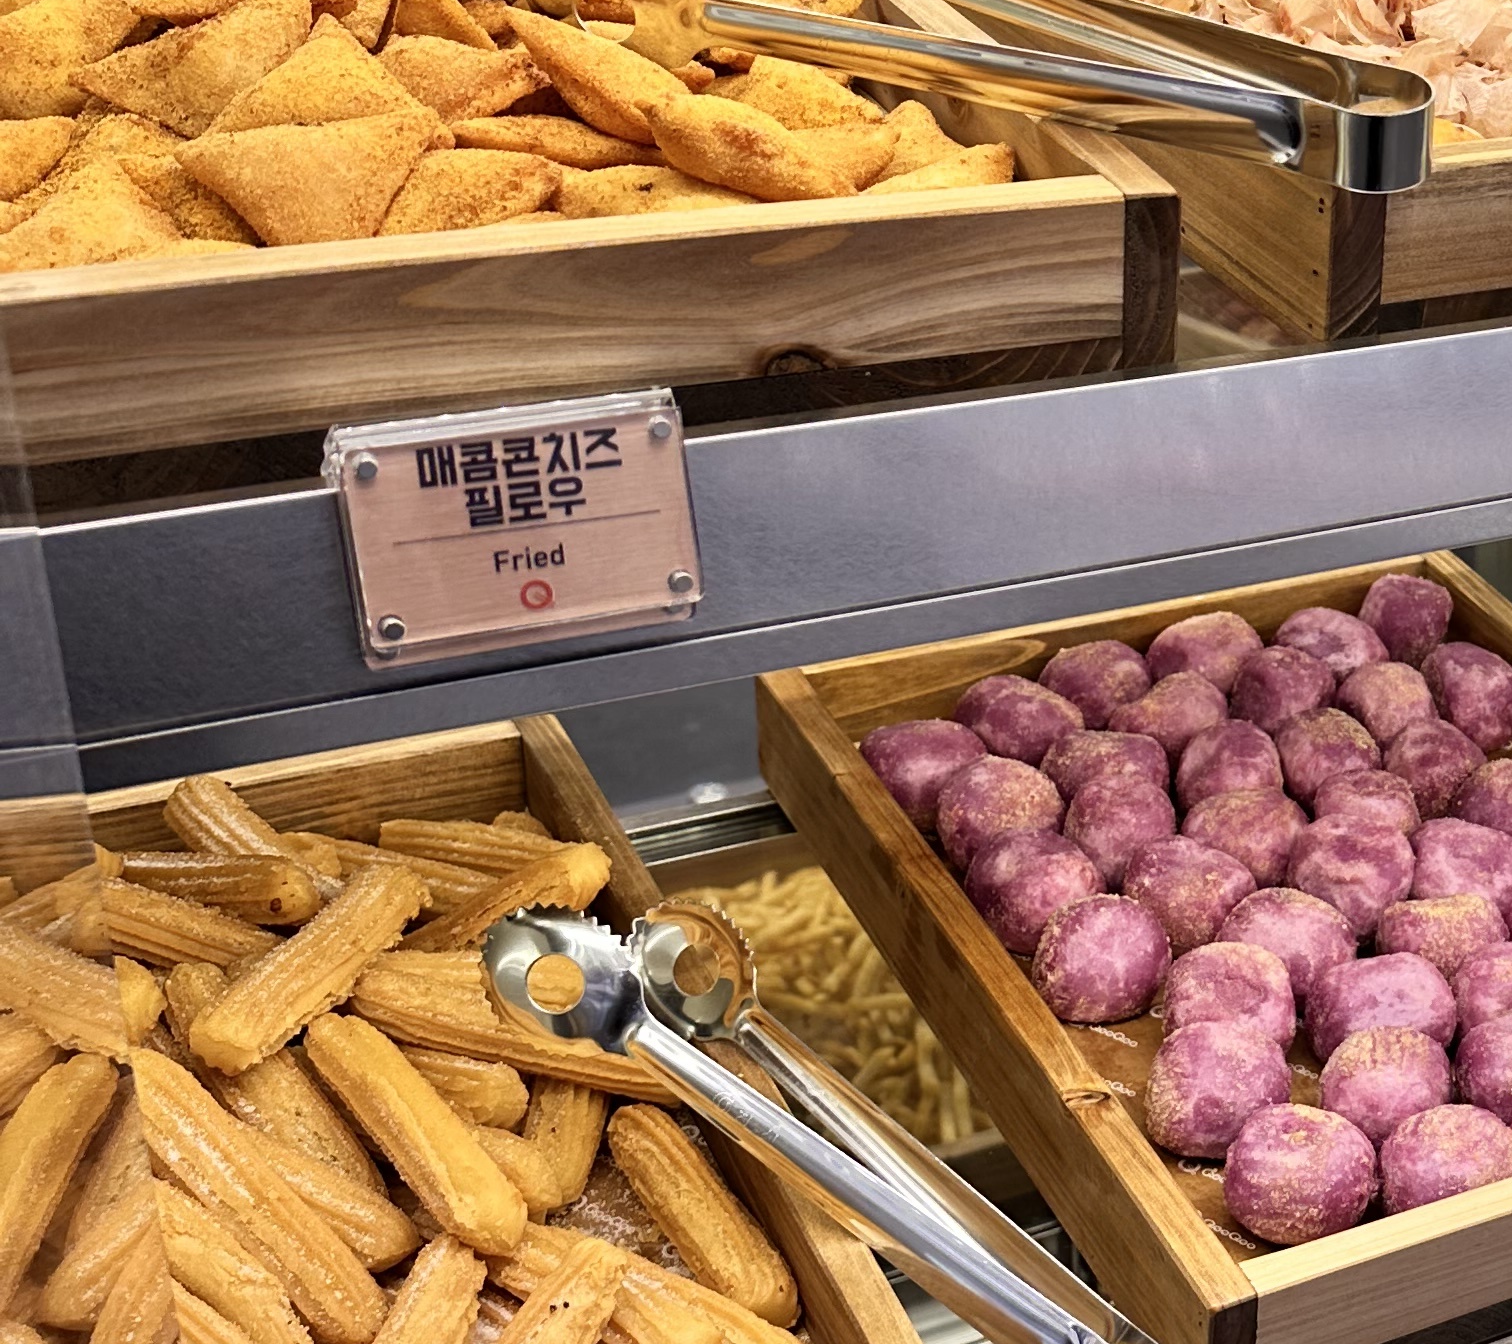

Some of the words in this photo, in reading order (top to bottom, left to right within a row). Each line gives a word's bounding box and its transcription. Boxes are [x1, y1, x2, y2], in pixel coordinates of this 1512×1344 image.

[415, 427, 623, 490] 매콤콘치즈
[464, 476, 587, 529] 필로우
[493, 543, 566, 574] Fried
